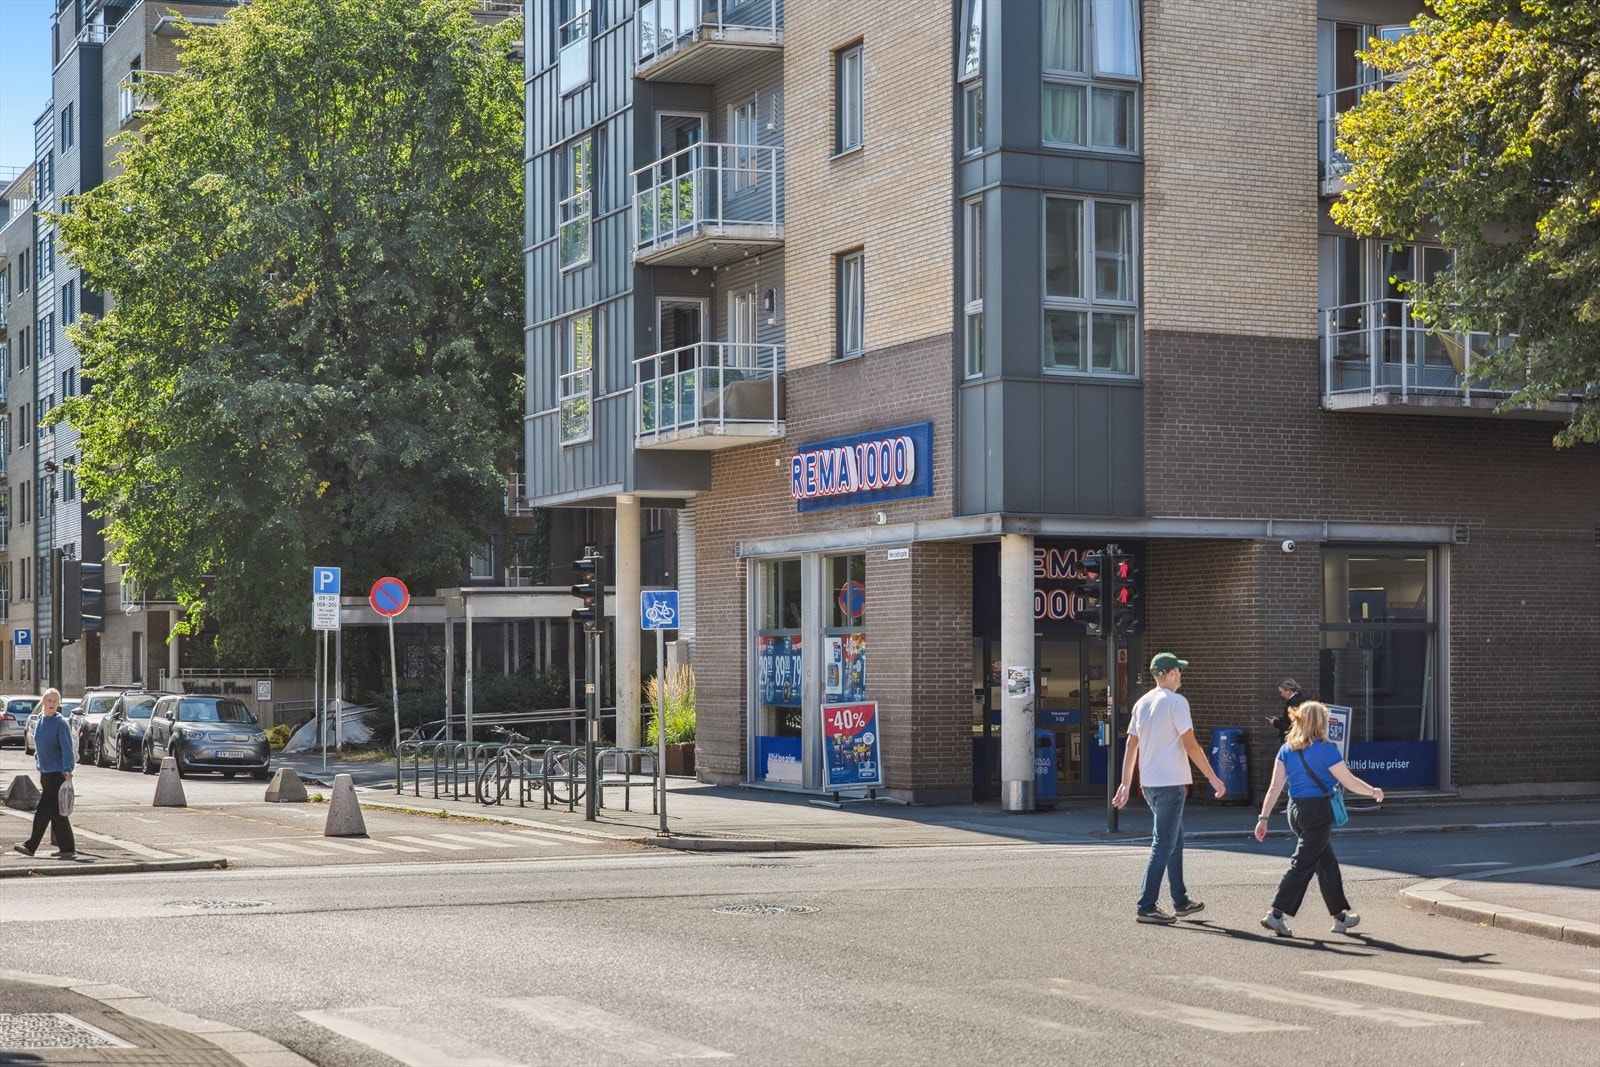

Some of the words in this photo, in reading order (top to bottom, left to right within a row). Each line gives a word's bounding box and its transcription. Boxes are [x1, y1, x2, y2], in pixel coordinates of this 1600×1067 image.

[791, 447, 853, 499] REMA
[856, 436, 912, 490] 1000
[320, 571, 334, 590] P
[18, 631, 28, 643] P
[828, 709, 865, 730] -40%
[1346, 760, 1367, 770] Alltid
[1368, 760, 1385, 769] lave
[1386, 759, 1410, 771] priser
